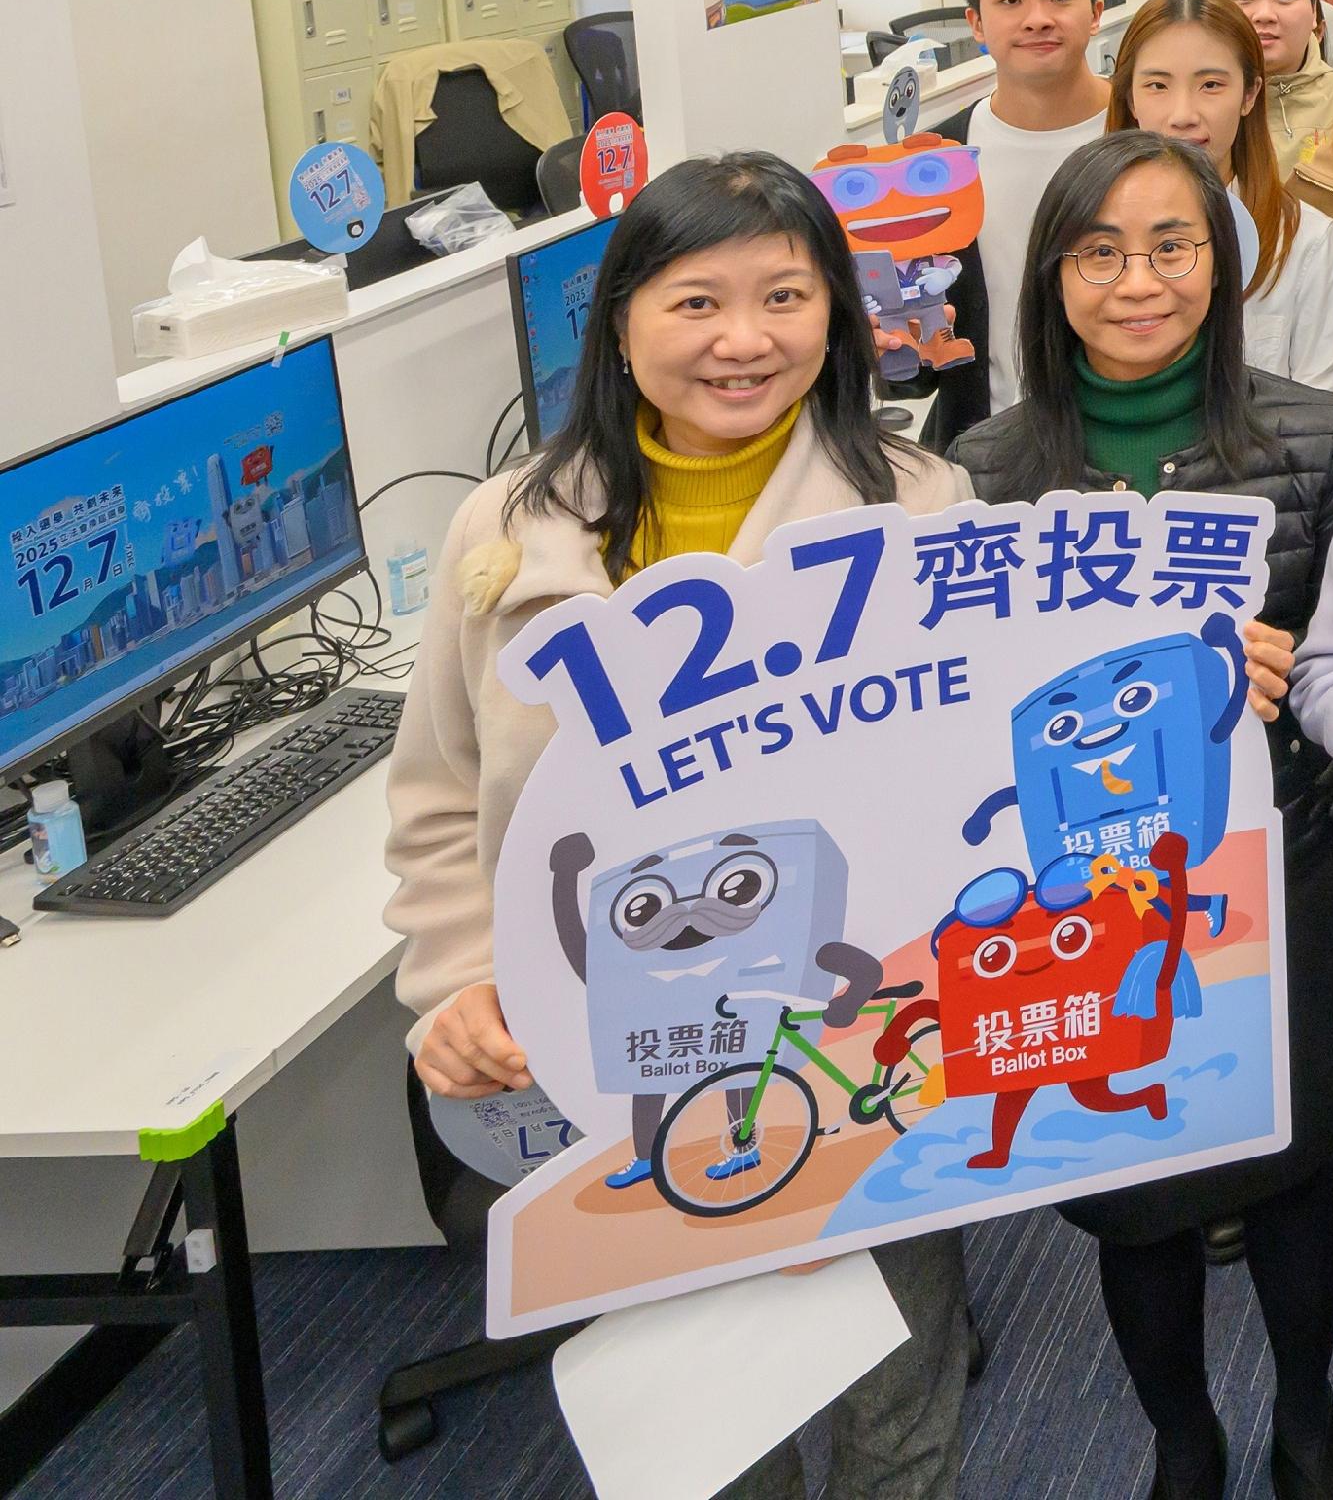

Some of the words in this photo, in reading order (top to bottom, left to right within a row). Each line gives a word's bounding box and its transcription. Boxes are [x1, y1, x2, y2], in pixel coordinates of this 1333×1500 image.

[11, 507, 64, 542] 投入選舉
[72, 484, 123, 517] 共創未來
[17, 530, 123, 618] 12月7日
[526, 526, 886, 749] 12.7
[915, 509, 1260, 631] 齊投票
[619, 701, 794, 810] LET'S
[801, 656, 971, 735] VOTE
[1062, 811, 1171, 877] 投票箱
[626, 1019, 749, 1064] 投票箱
[974, 991, 1102, 1058] 投票箱
[640, 1060, 691, 1079] Ballot
[694, 1057, 729, 1076] Box
[991, 1049, 1047, 1077] Ballot
[1050, 1043, 1088, 1069] Box
